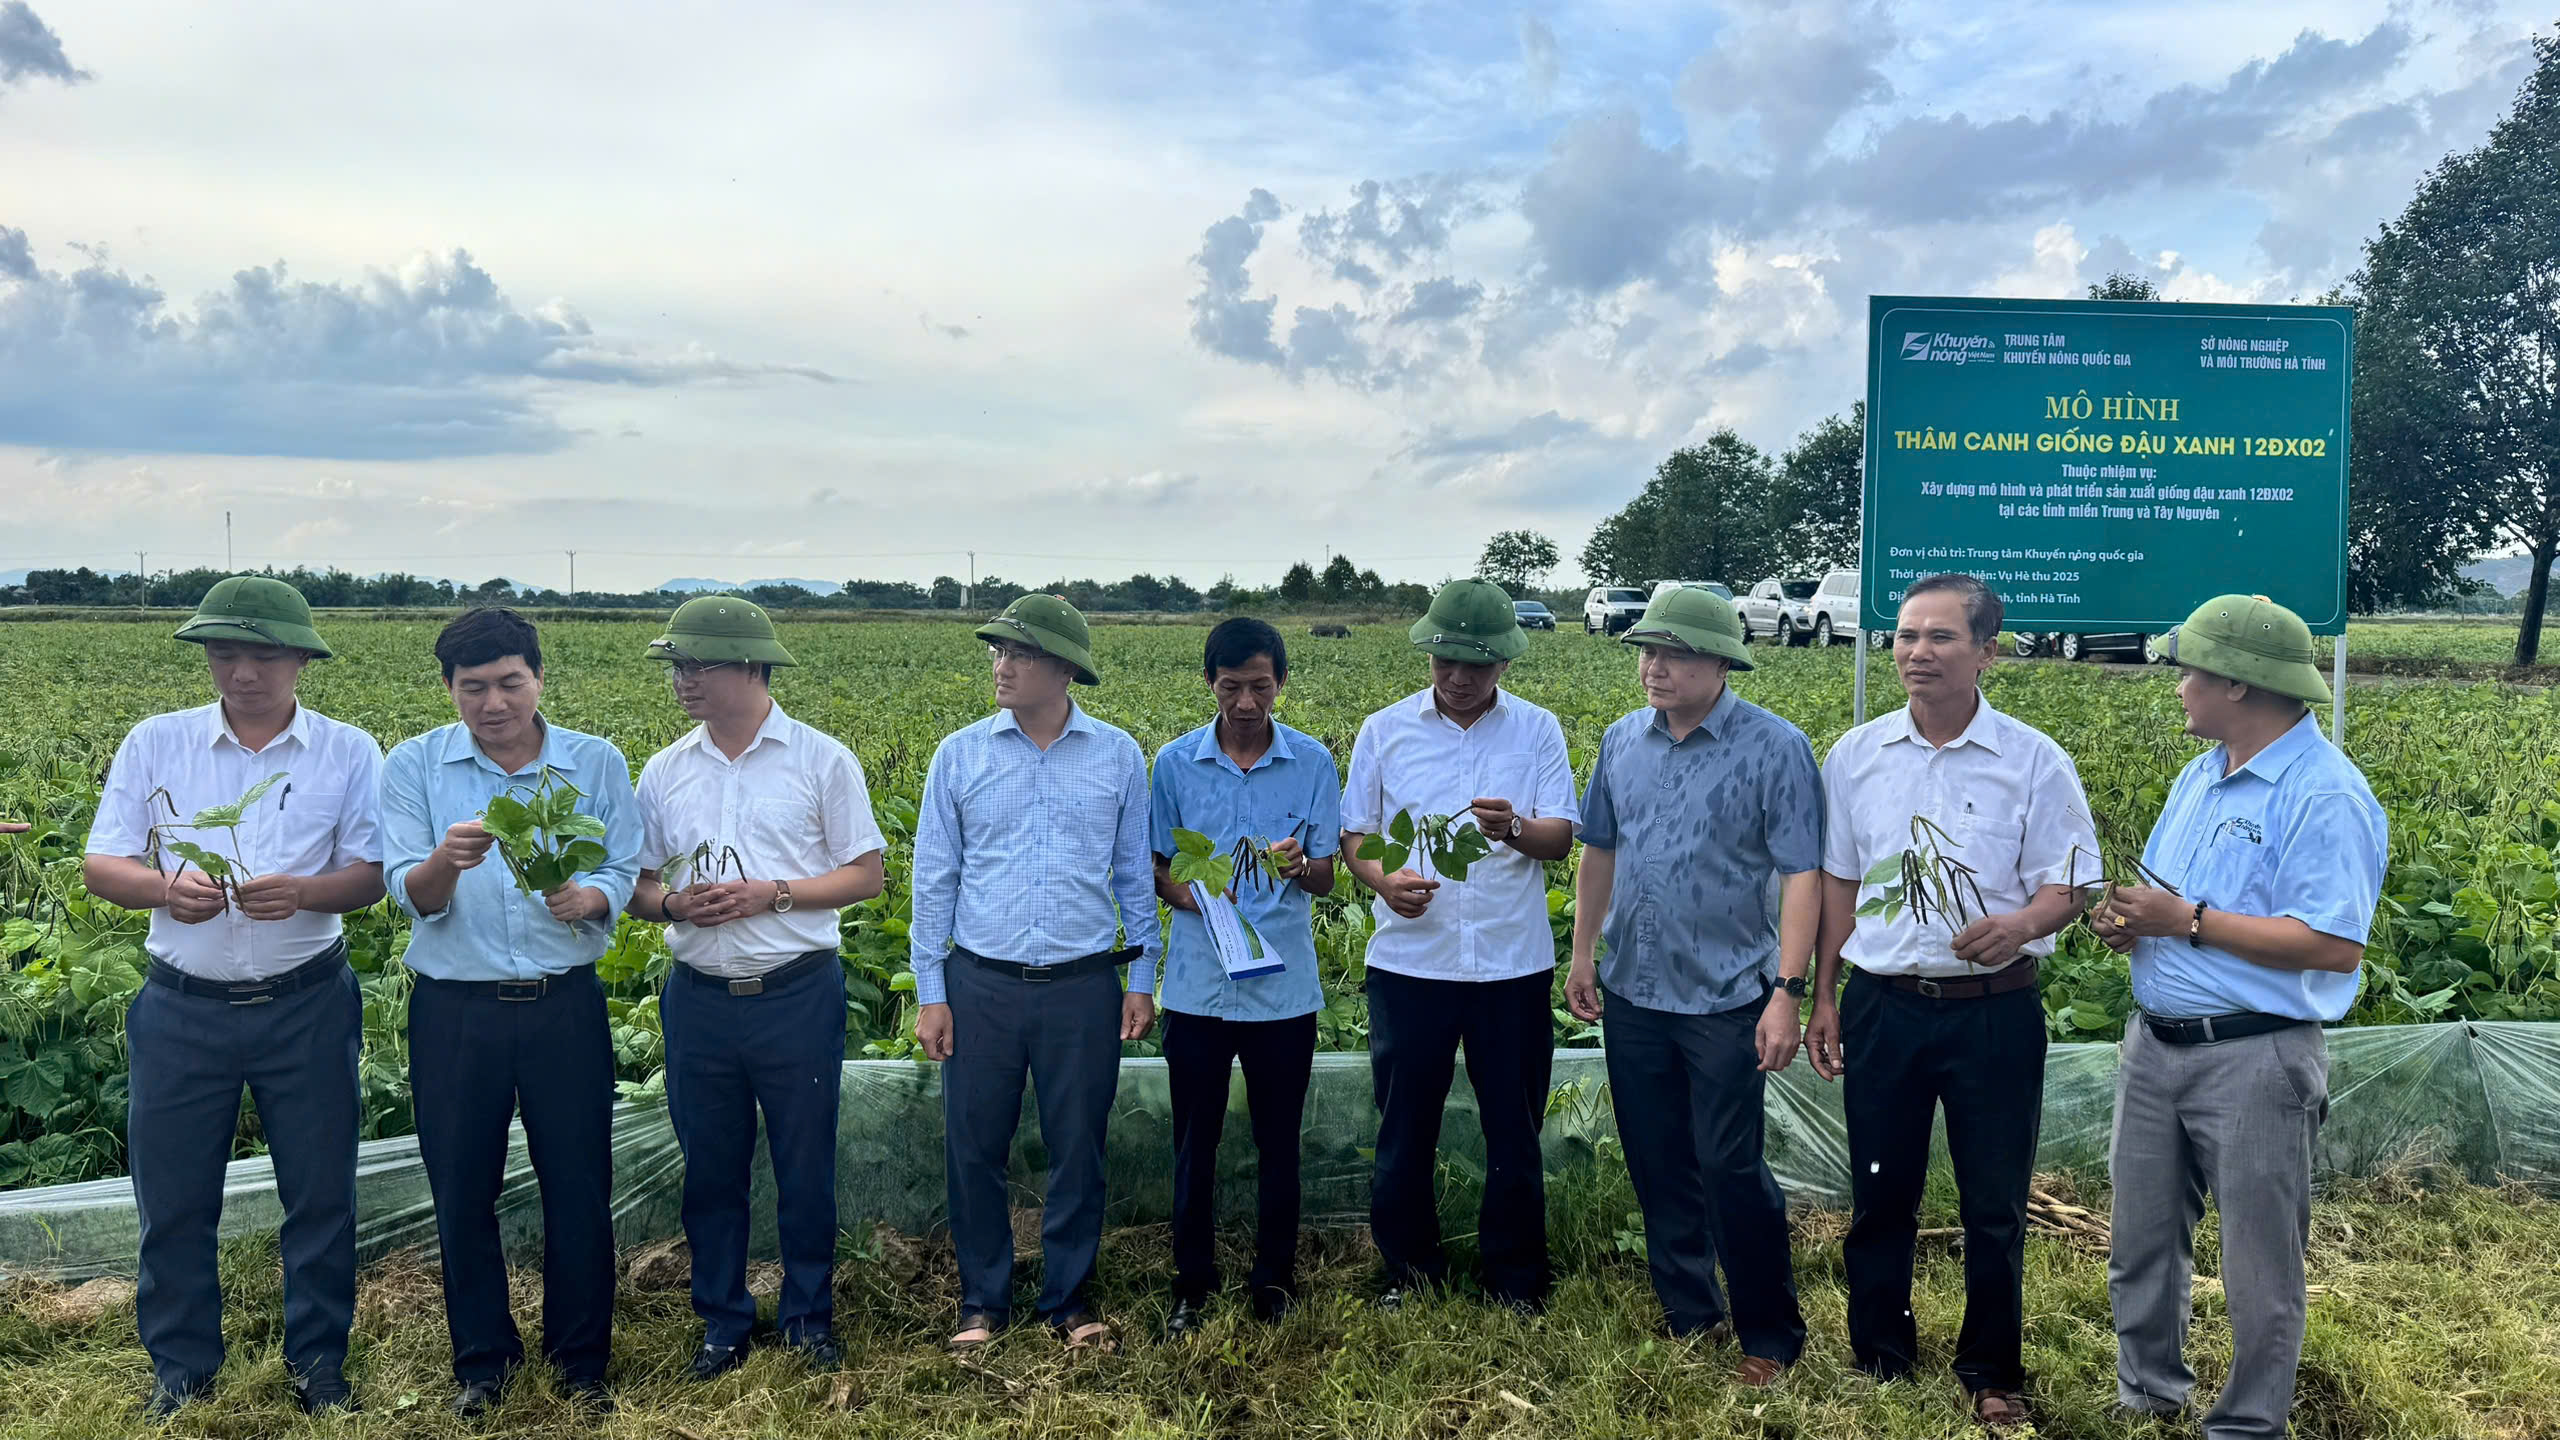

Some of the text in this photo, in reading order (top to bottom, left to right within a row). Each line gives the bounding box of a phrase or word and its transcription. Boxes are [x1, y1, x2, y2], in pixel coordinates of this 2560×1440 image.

[2004, 333, 2065, 347] TRUNG TÂM
[2201, 335, 2289, 354] SỞ NÔNG NGHIỆP
[1930, 348, 1967, 365] nông
[2003, 348, 2131, 367] KHUYẾN NÔNG QUỐC GIA
[2200, 354, 2326, 370] VÀ MÔI TRƯỜNG HÀ TĨNH
[2045, 389, 2180, 421] MÔ HÌNH
[1895, 426, 2326, 459] THÂM CANH GIỐNG ĐẬU XANH 12ĐX02
[2062, 464, 2157, 481] Thuộc nhiệm vụ:
[1920, 481, 2294, 502] Xây dựng mô hình và phát triển sản xuất giống đậu xanh 12ĐX02
[1999, 502, 2220, 520] tại các tỉnh miền Trung và Tây Nguyên
[1890, 547, 2144, 562] Đơn vị chủ trì: Trung tâm Khuyến nông quốc gia
[1889, 569, 1914, 579] Thời
[1998, 571, 2012, 583] Vụ
[2015, 571, 2030, 580] Hè
[2032, 571, 2051, 581] thu
[2052, 572, 2080, 581] 2025
[2016, 592, 2038, 603] tỉnh
[2040, 593, 2055, 603] Hà
[2056, 593, 2081, 603] Tĩnh
